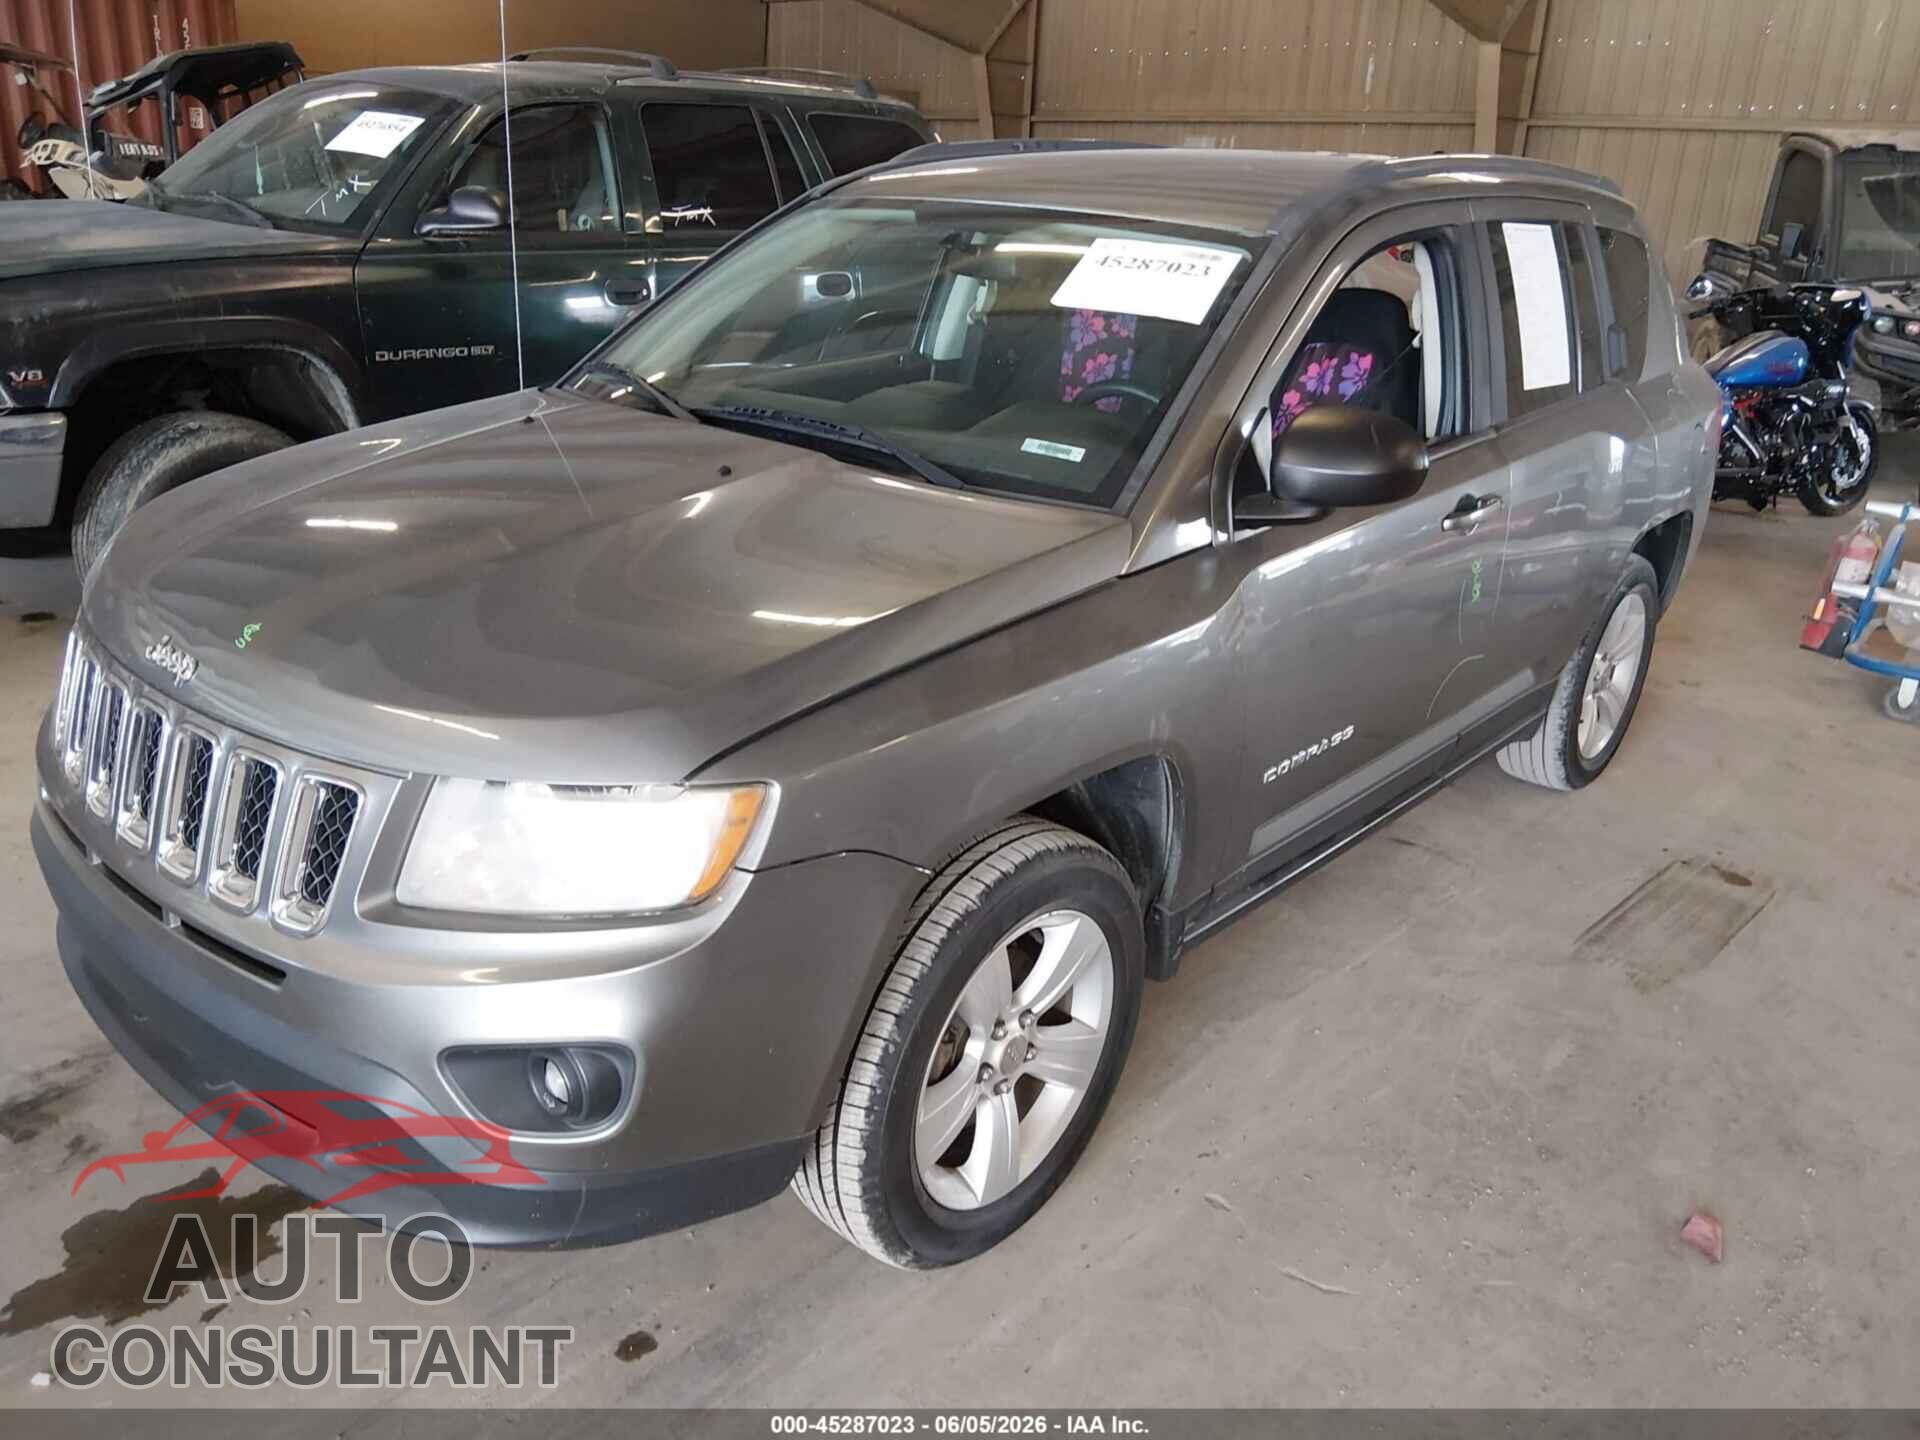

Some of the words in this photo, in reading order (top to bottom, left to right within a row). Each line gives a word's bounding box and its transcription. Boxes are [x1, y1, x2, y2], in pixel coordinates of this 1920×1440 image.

[1096, 254, 1212, 278] 45287023
[375, 346, 469, 362] DURANGO
[8, 369, 43, 382] V8
[145, 634, 196, 689] Jeep
[1263, 724, 1355, 784] COMPASS
